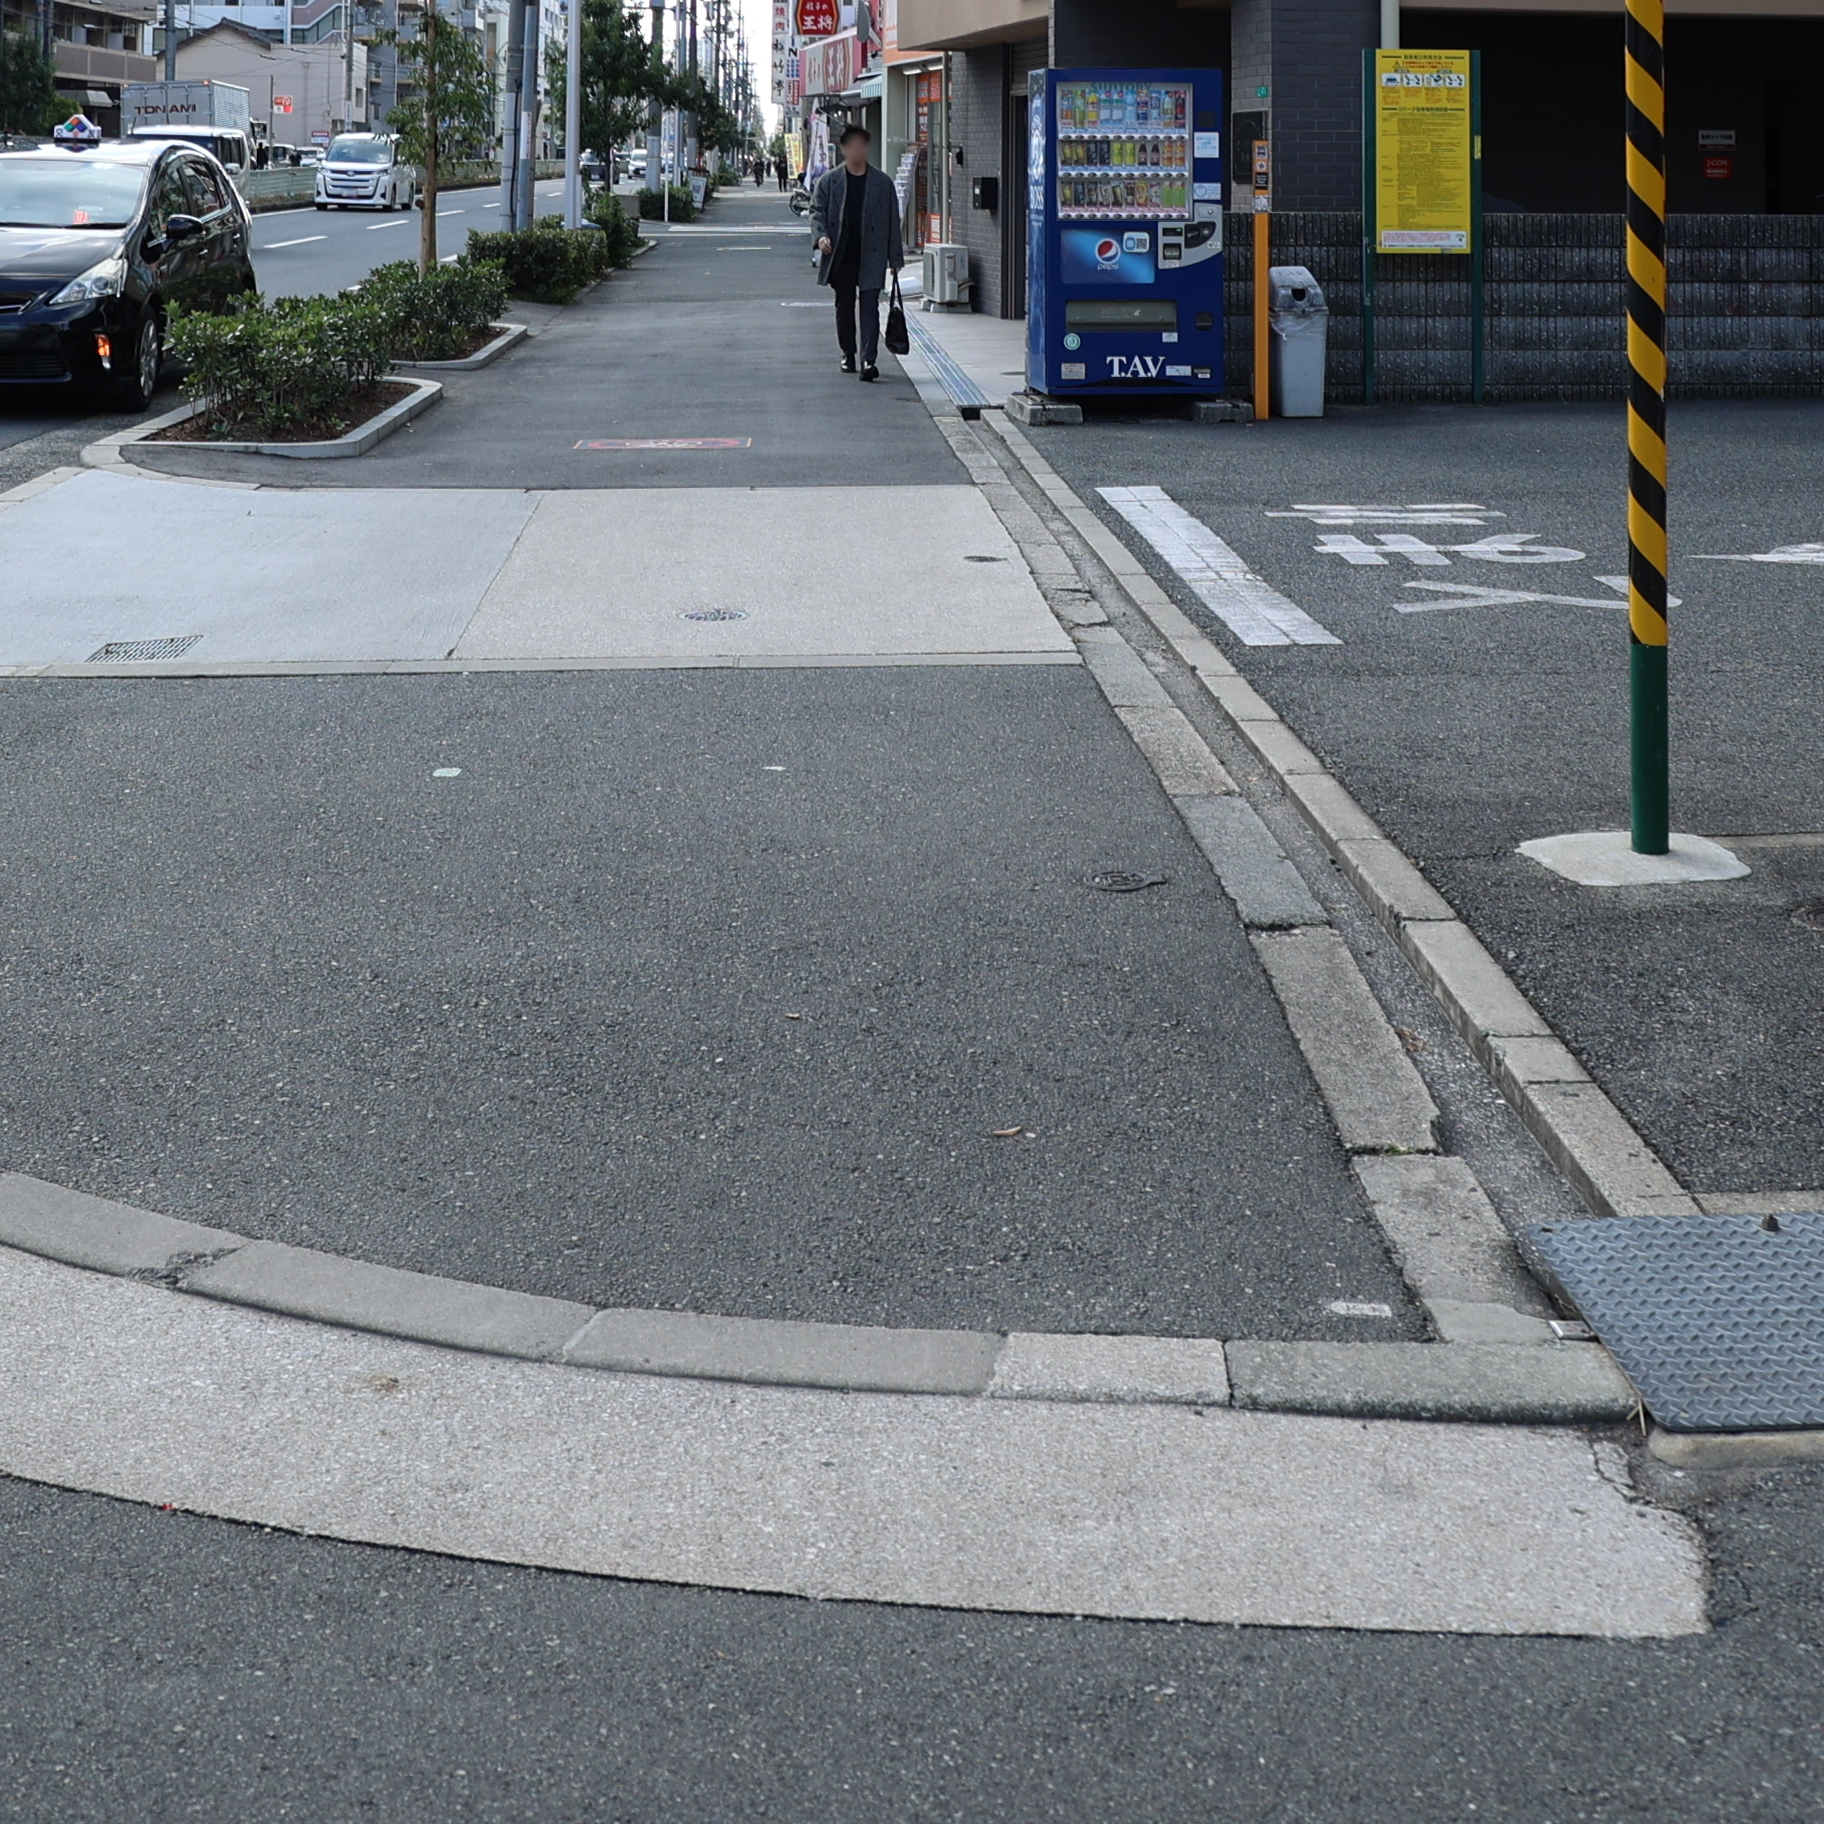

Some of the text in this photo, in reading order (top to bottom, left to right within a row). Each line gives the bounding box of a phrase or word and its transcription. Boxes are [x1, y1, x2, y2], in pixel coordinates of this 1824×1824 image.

[805, 1, 829, 11] 餃子の
[802, 14, 833, 31] 王将
[134, 104, 197, 115] TONAMI
[1097, 263, 1119, 271] pepsi
